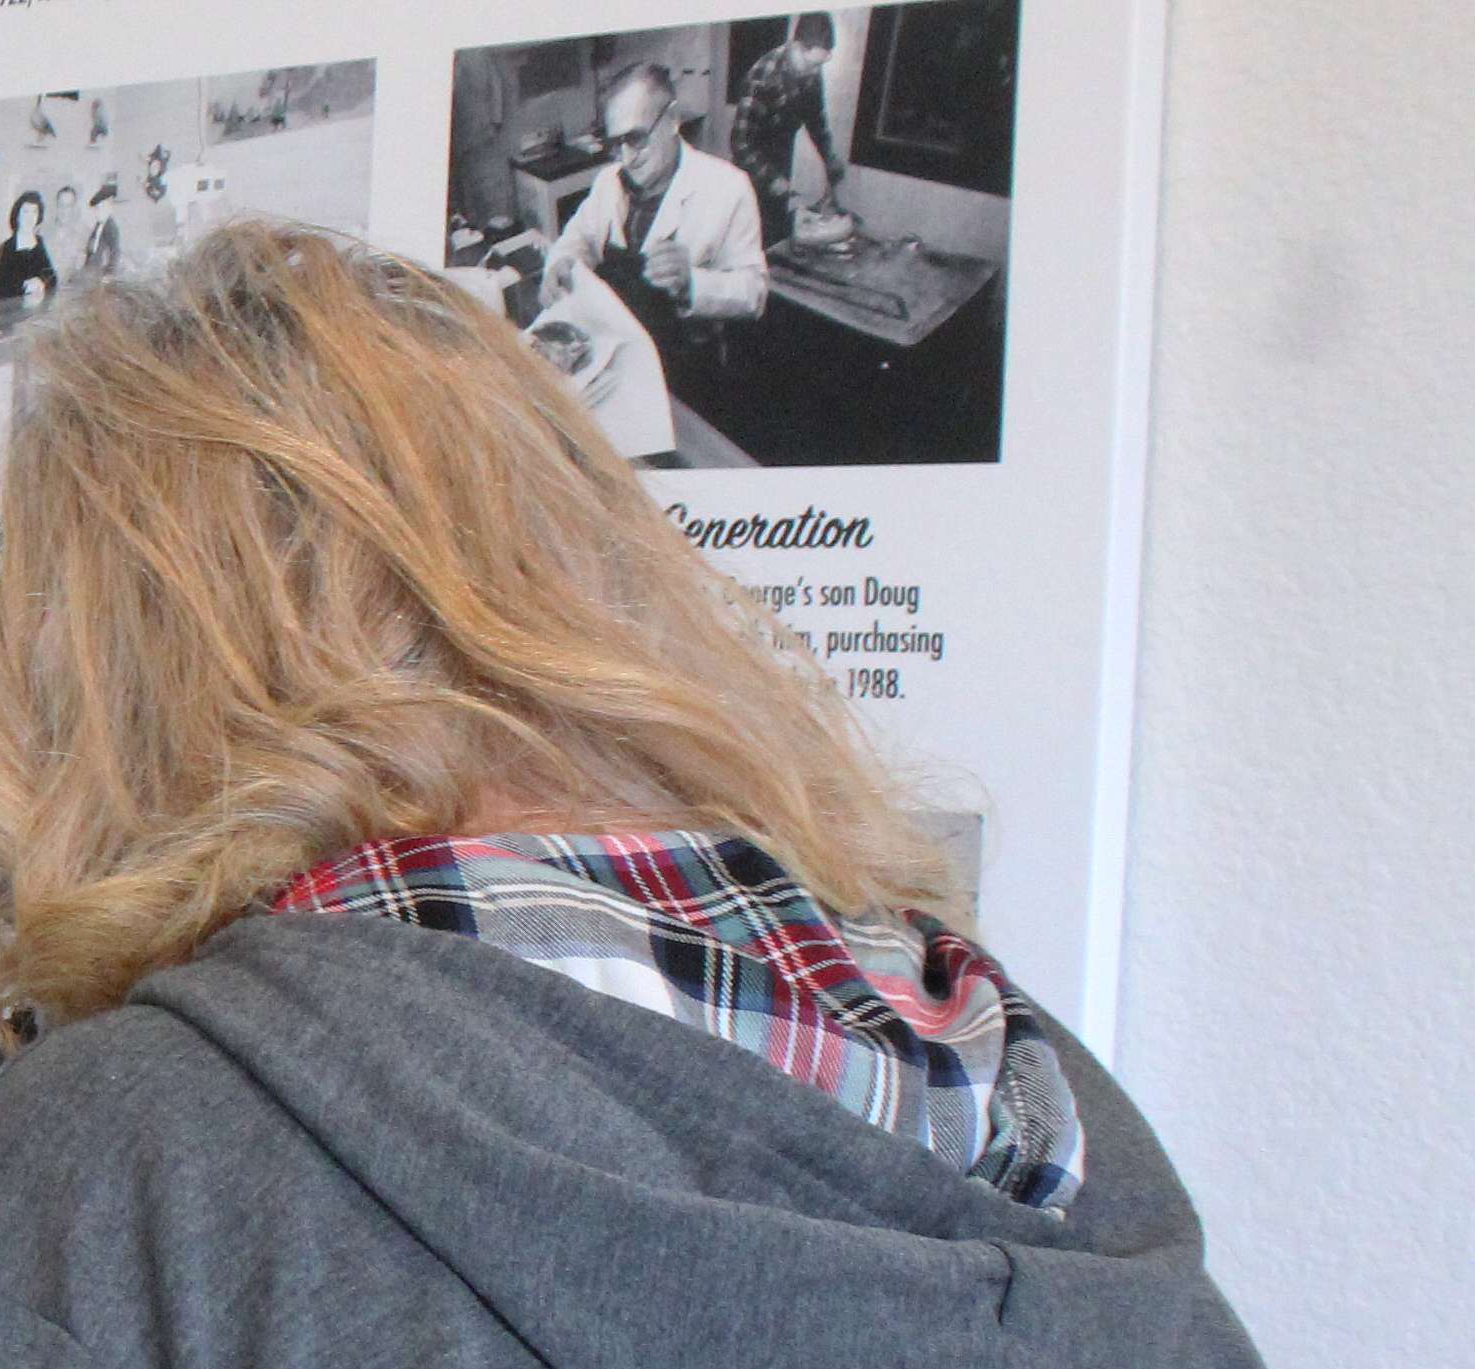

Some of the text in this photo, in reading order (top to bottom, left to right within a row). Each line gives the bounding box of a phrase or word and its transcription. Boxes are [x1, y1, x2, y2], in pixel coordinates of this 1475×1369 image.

[820, 586, 855, 606] son
[864, 576, 920, 614] Doug
[826, 619, 944, 661] purchasing
[848, 667, 906, 699] 1988.
